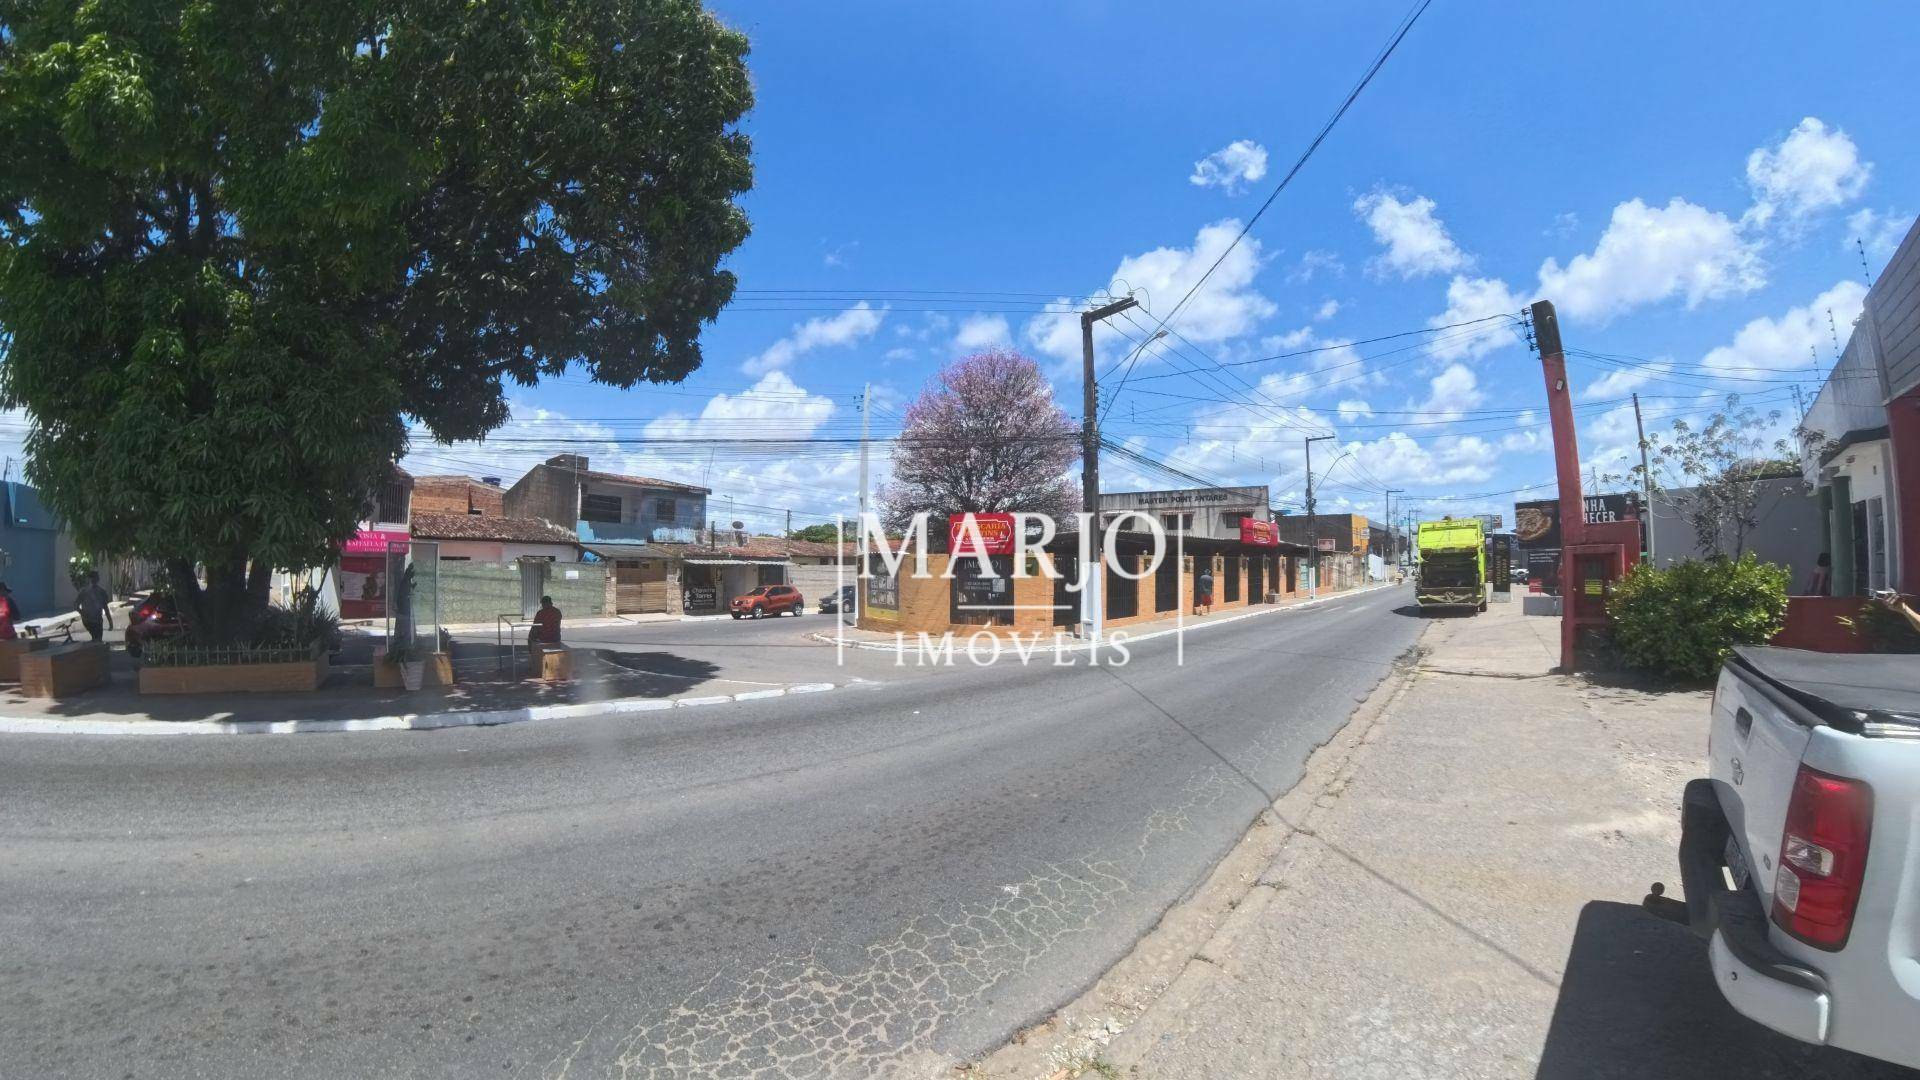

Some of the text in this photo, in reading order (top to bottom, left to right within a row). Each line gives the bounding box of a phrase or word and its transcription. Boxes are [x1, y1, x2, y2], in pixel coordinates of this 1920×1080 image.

[1138, 493, 1228, 505] MASTER POINT ANTARES
[1583, 499, 1606, 512] NHA
[1583, 511, 1616, 523] HECER
